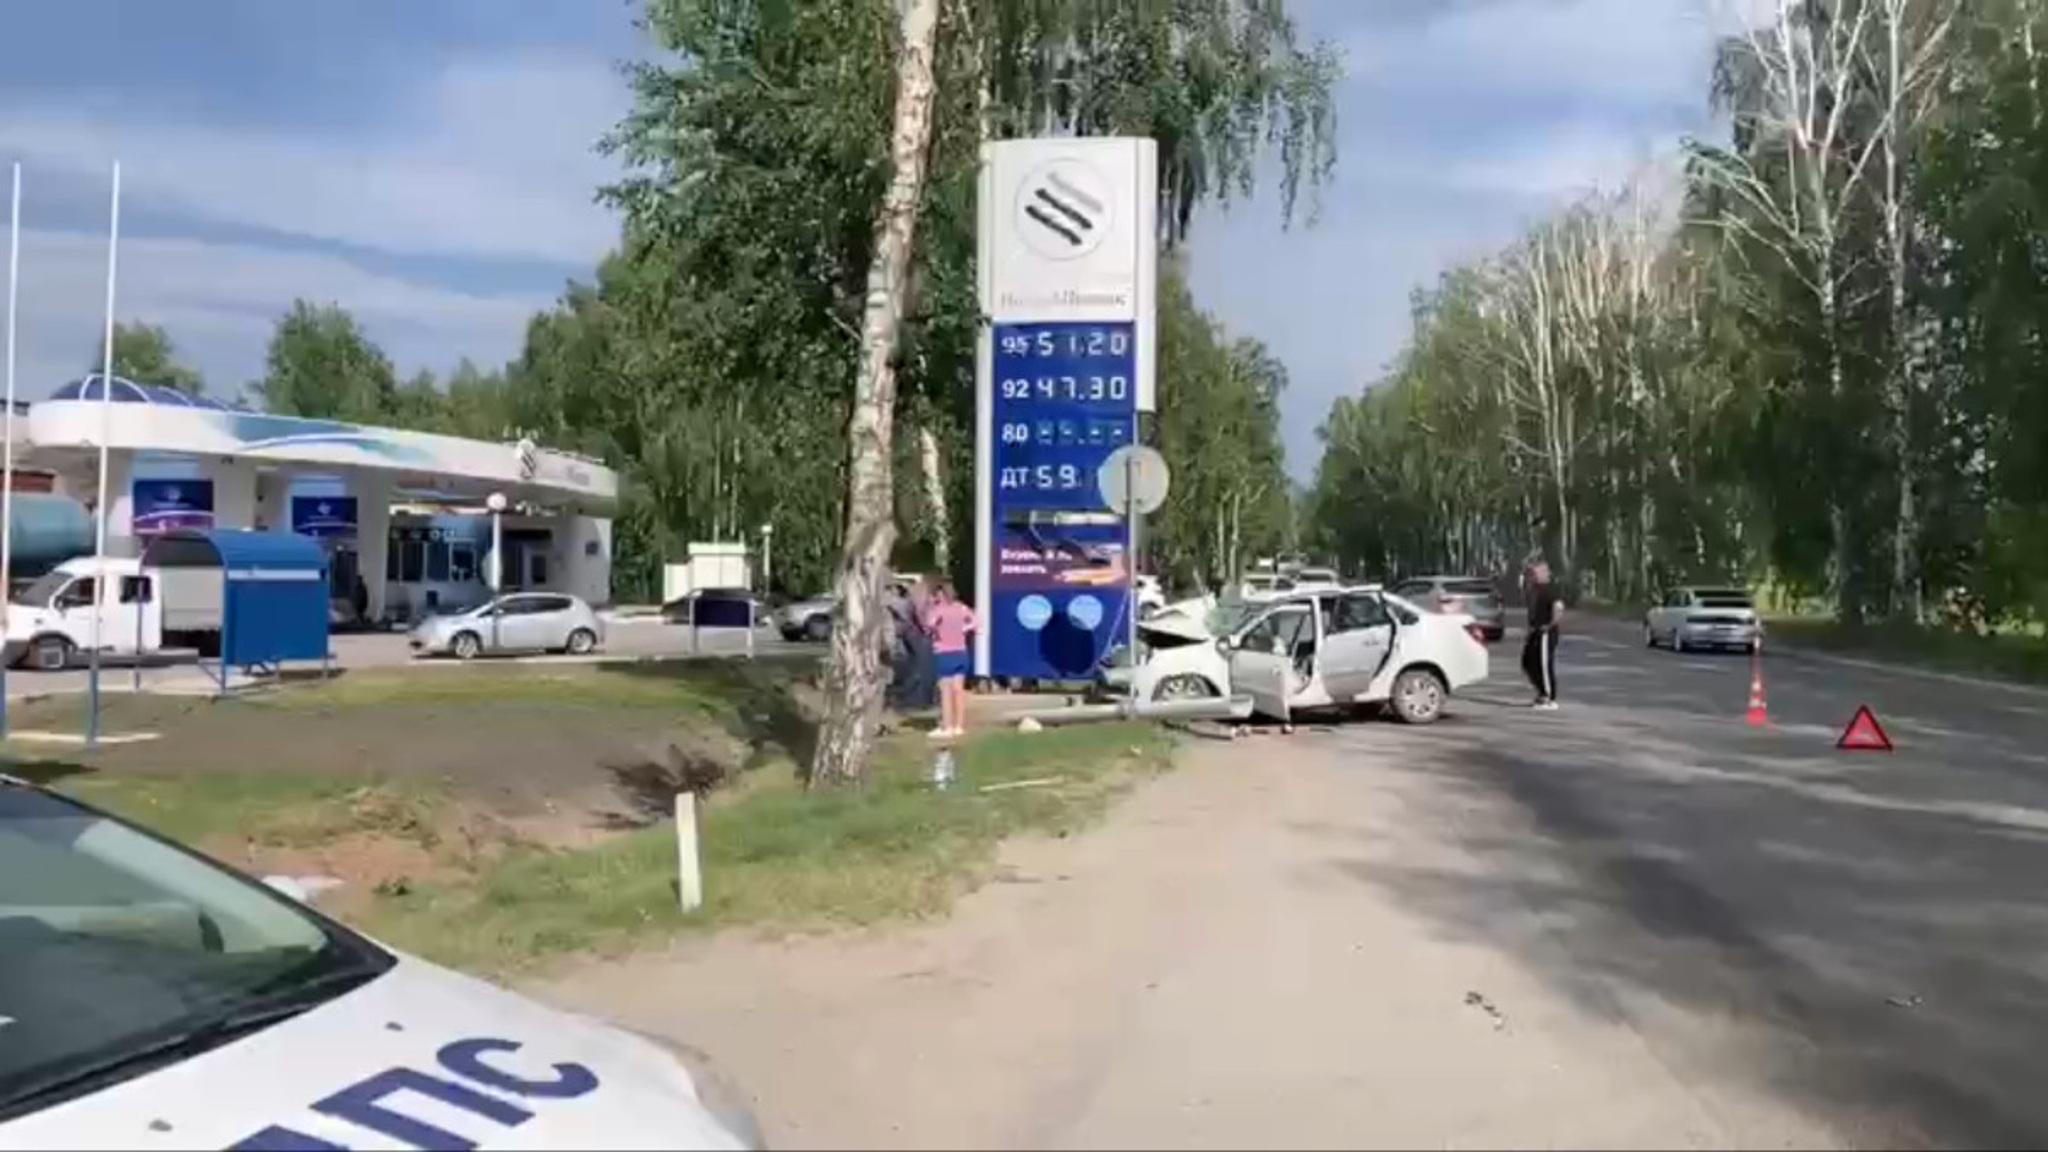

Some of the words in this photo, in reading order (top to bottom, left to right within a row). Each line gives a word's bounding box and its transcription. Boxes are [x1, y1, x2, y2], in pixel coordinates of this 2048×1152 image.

[1001, 335, 1029, 355] 95
[1001, 378, 1030, 399] 92
[1036, 375, 1127, 400] 47.30
[1001, 422, 1029, 443] 80
[1000, 466, 1030, 488] ДТ
